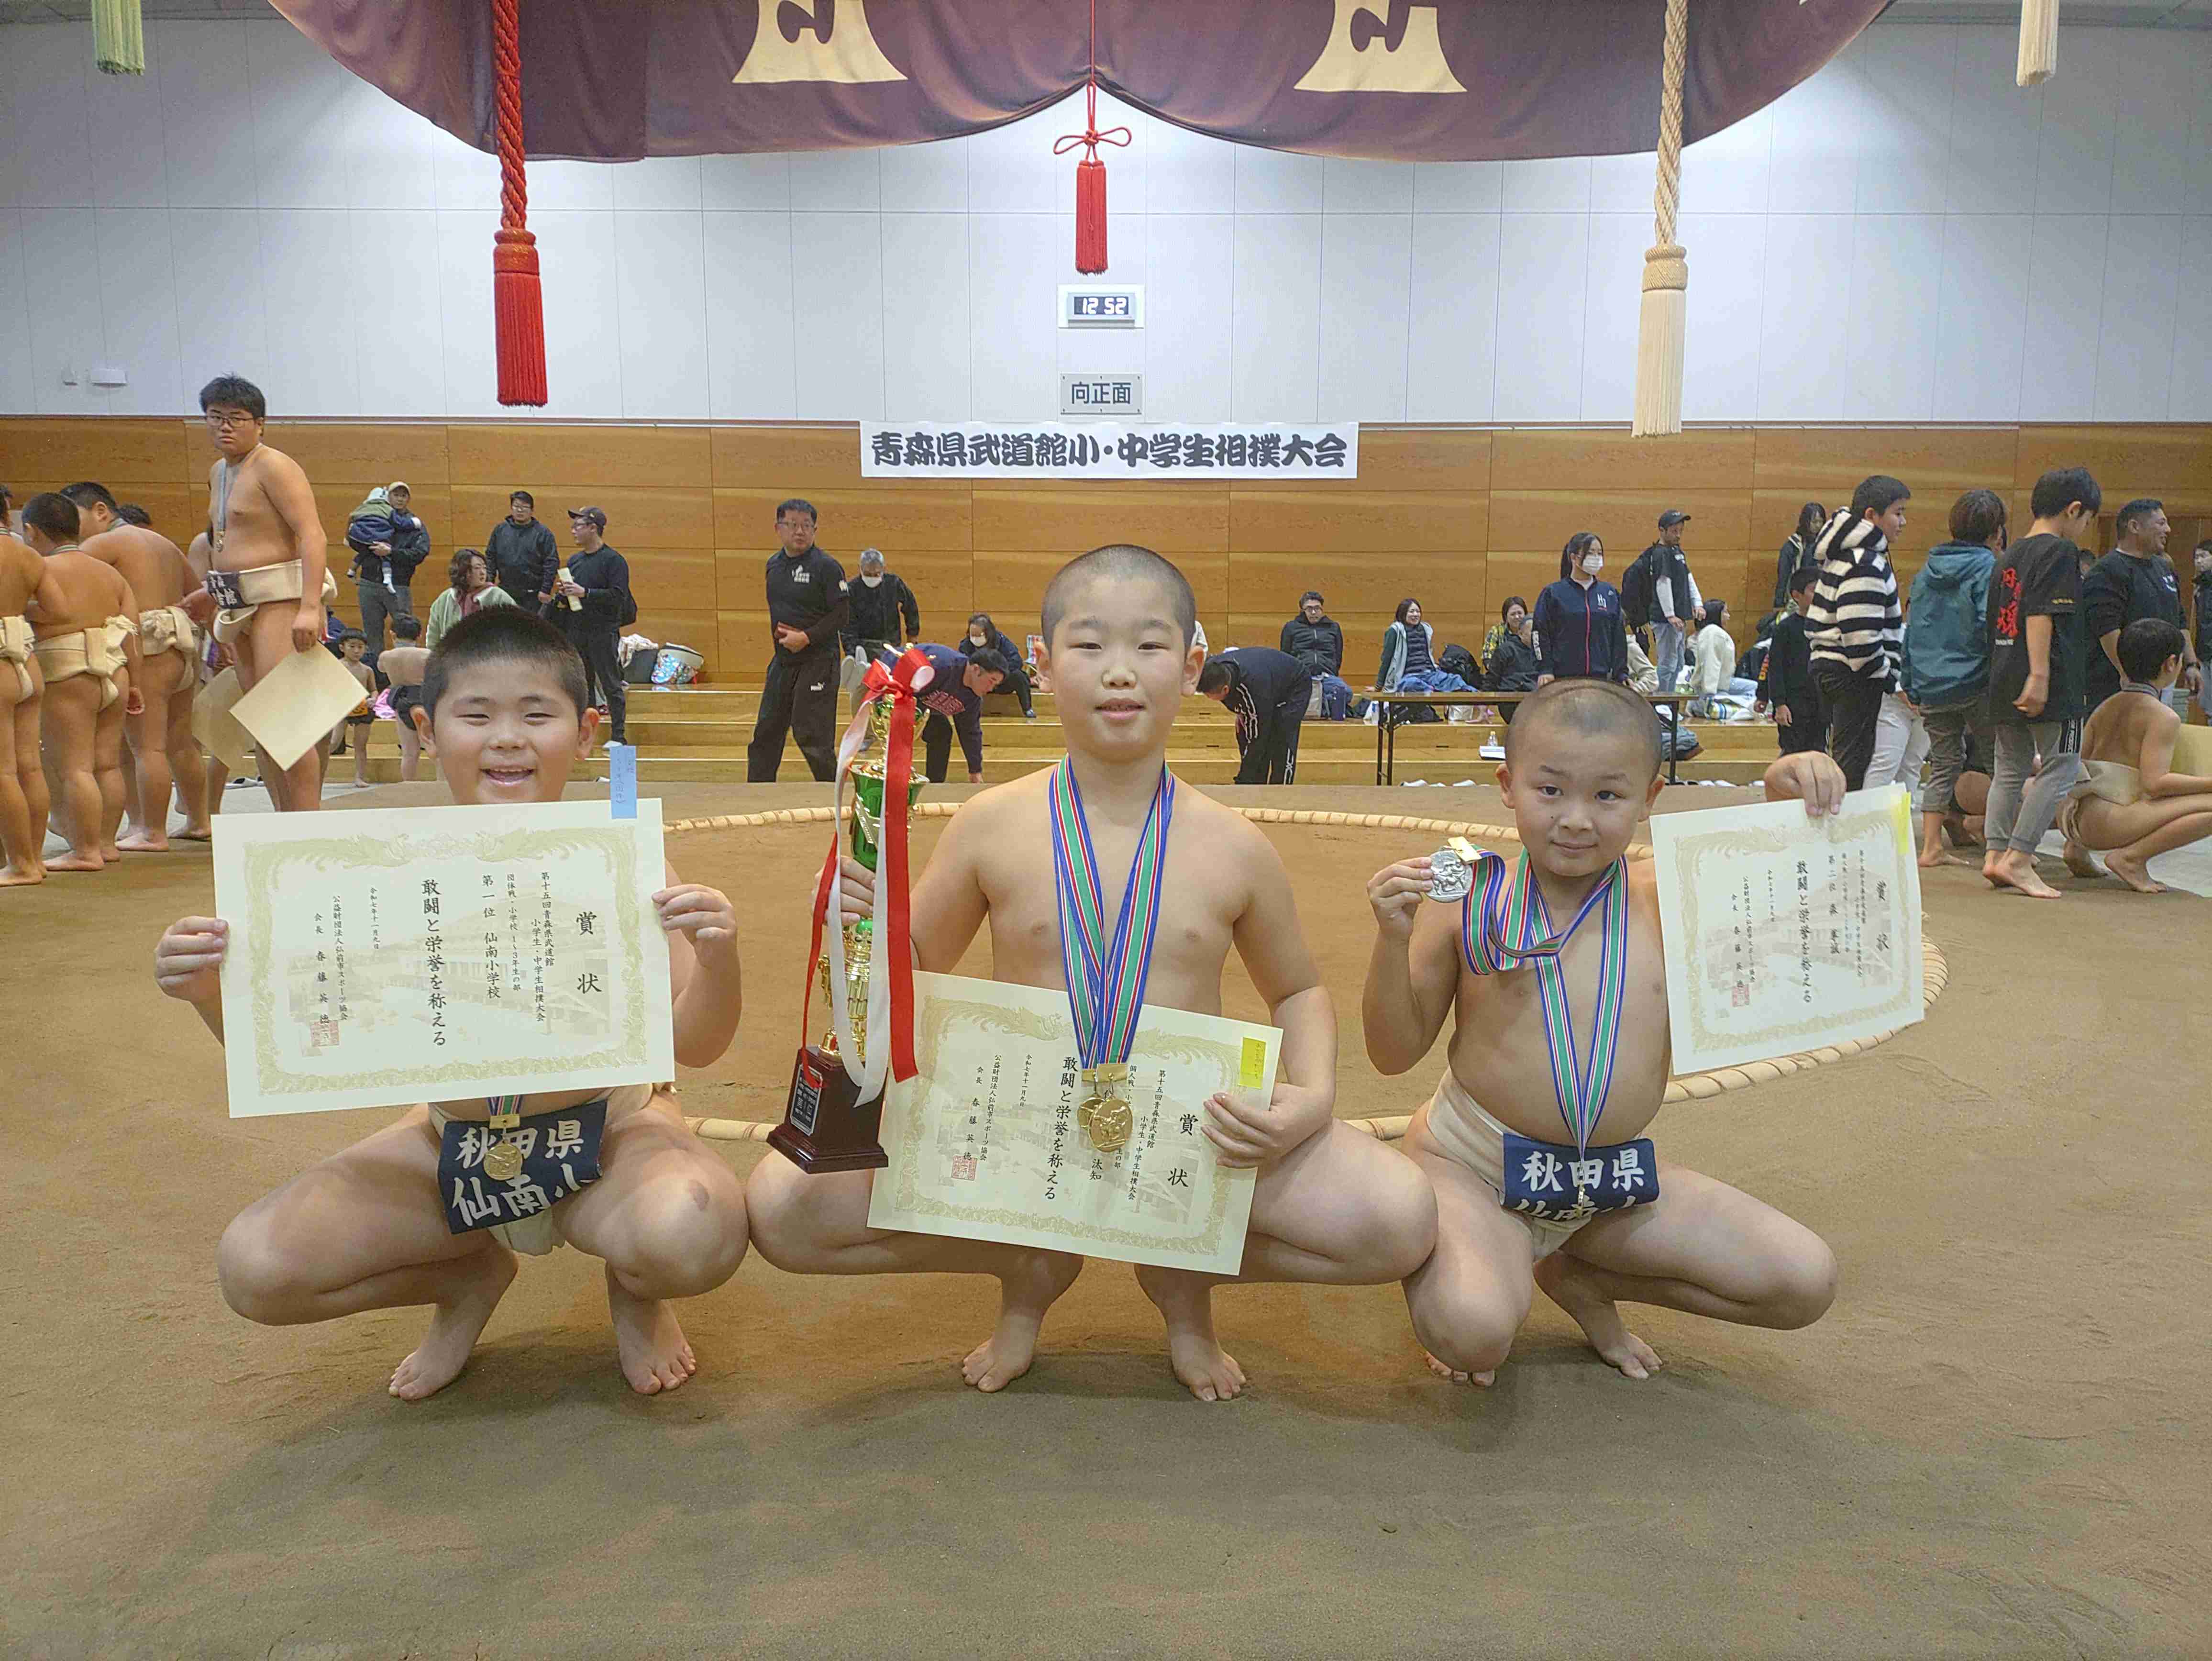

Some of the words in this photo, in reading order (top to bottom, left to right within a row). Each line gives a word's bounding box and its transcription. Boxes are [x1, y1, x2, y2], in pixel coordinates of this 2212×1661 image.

[1082, 297, 1099, 314] 12
[1104, 297, 1127, 314] 52
[1071, 381, 1131, 404] 向正面
[871, 432, 1348, 468] 青森県武道館小・中学生相撲大会
[482, 874, 496, 918] 第一位
[541, 872, 555, 966] 第十五回青森県武道館
[421, 879, 446, 1046] 敢闘と栄誉を称える
[484, 932, 501, 999] 仙南小学校
[576, 911, 602, 994] 賞状
[975, 1066, 984, 1085] 会長
[980, 1054, 1002, 1162] 公益財団法人弘前市スポーツ協会
[1019, 1053, 1032, 1107] 令和七年十一月九日
[1147, 1070, 1166, 1148] 第十五回青森県武道館
[1045, 1056, 1079, 1200] 敢闘と栄誉を称える
[1167, 1113, 1198, 1187] 賞状
[1521, 1147, 1645, 1192] 秋田県
